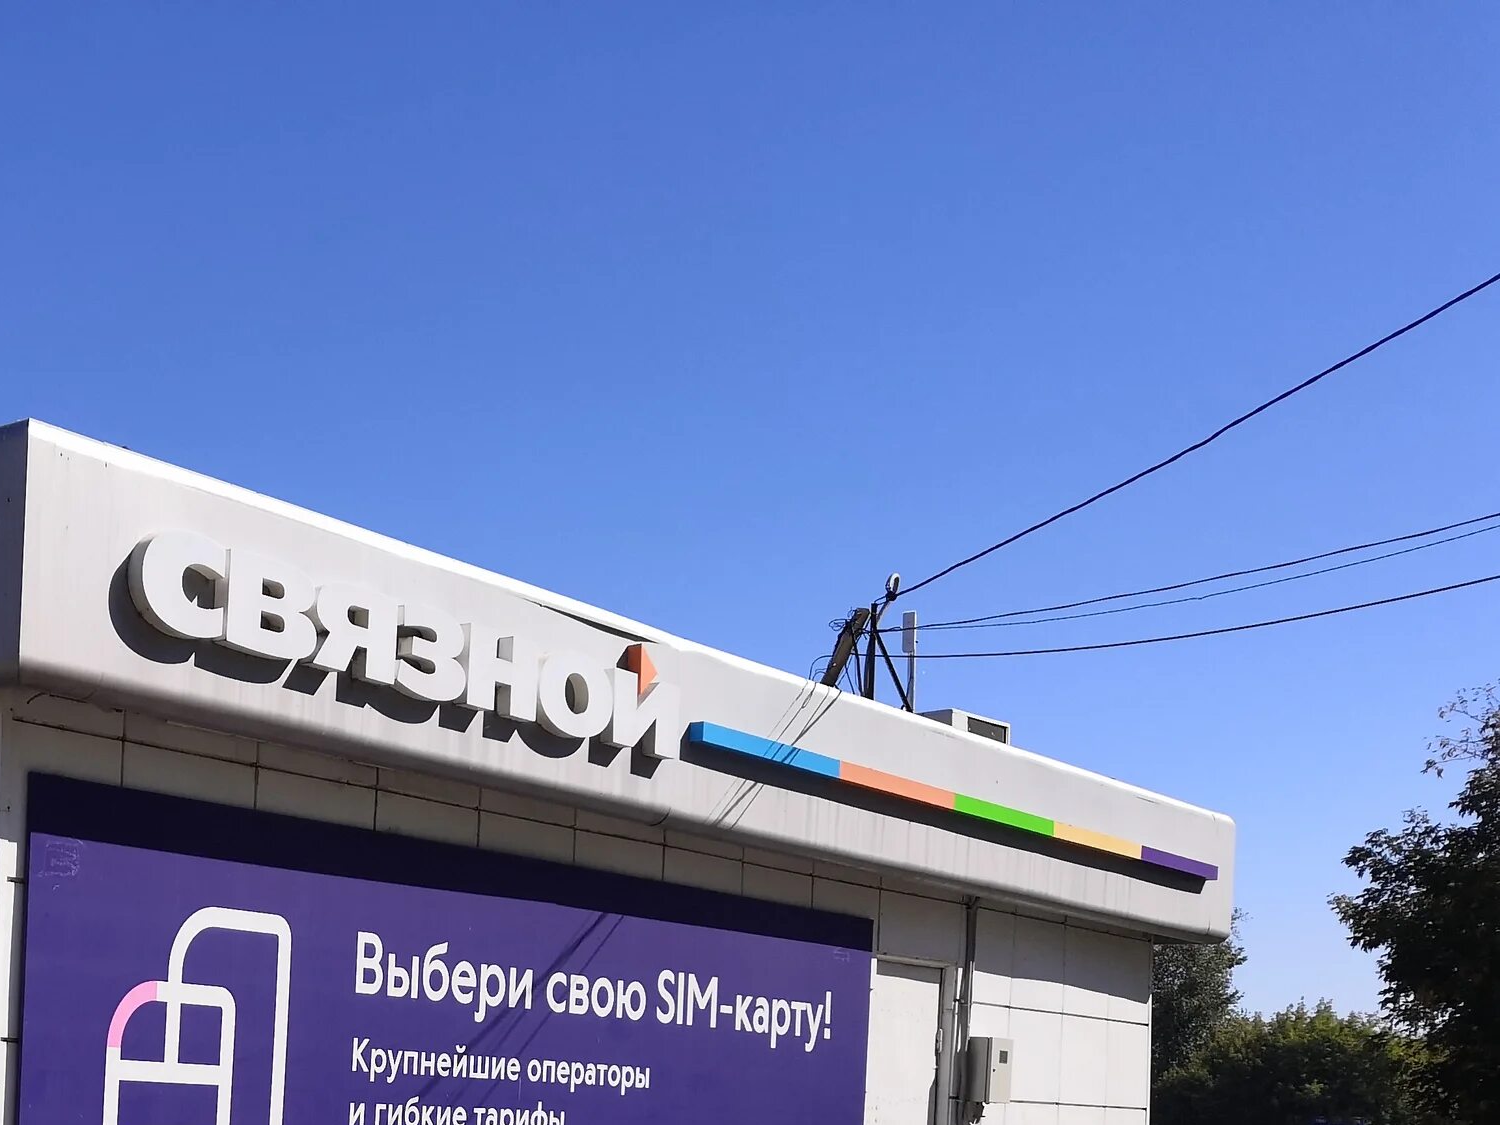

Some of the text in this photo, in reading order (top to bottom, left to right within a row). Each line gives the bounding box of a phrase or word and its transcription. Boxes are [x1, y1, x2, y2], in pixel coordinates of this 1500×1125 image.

[128, 531, 680, 760] СВЯЗНОЙ
[355, 931, 832, 1052] Выбери свою SIM-карту!
[351, 1037, 650, 1096] Крупнейшие операторы
